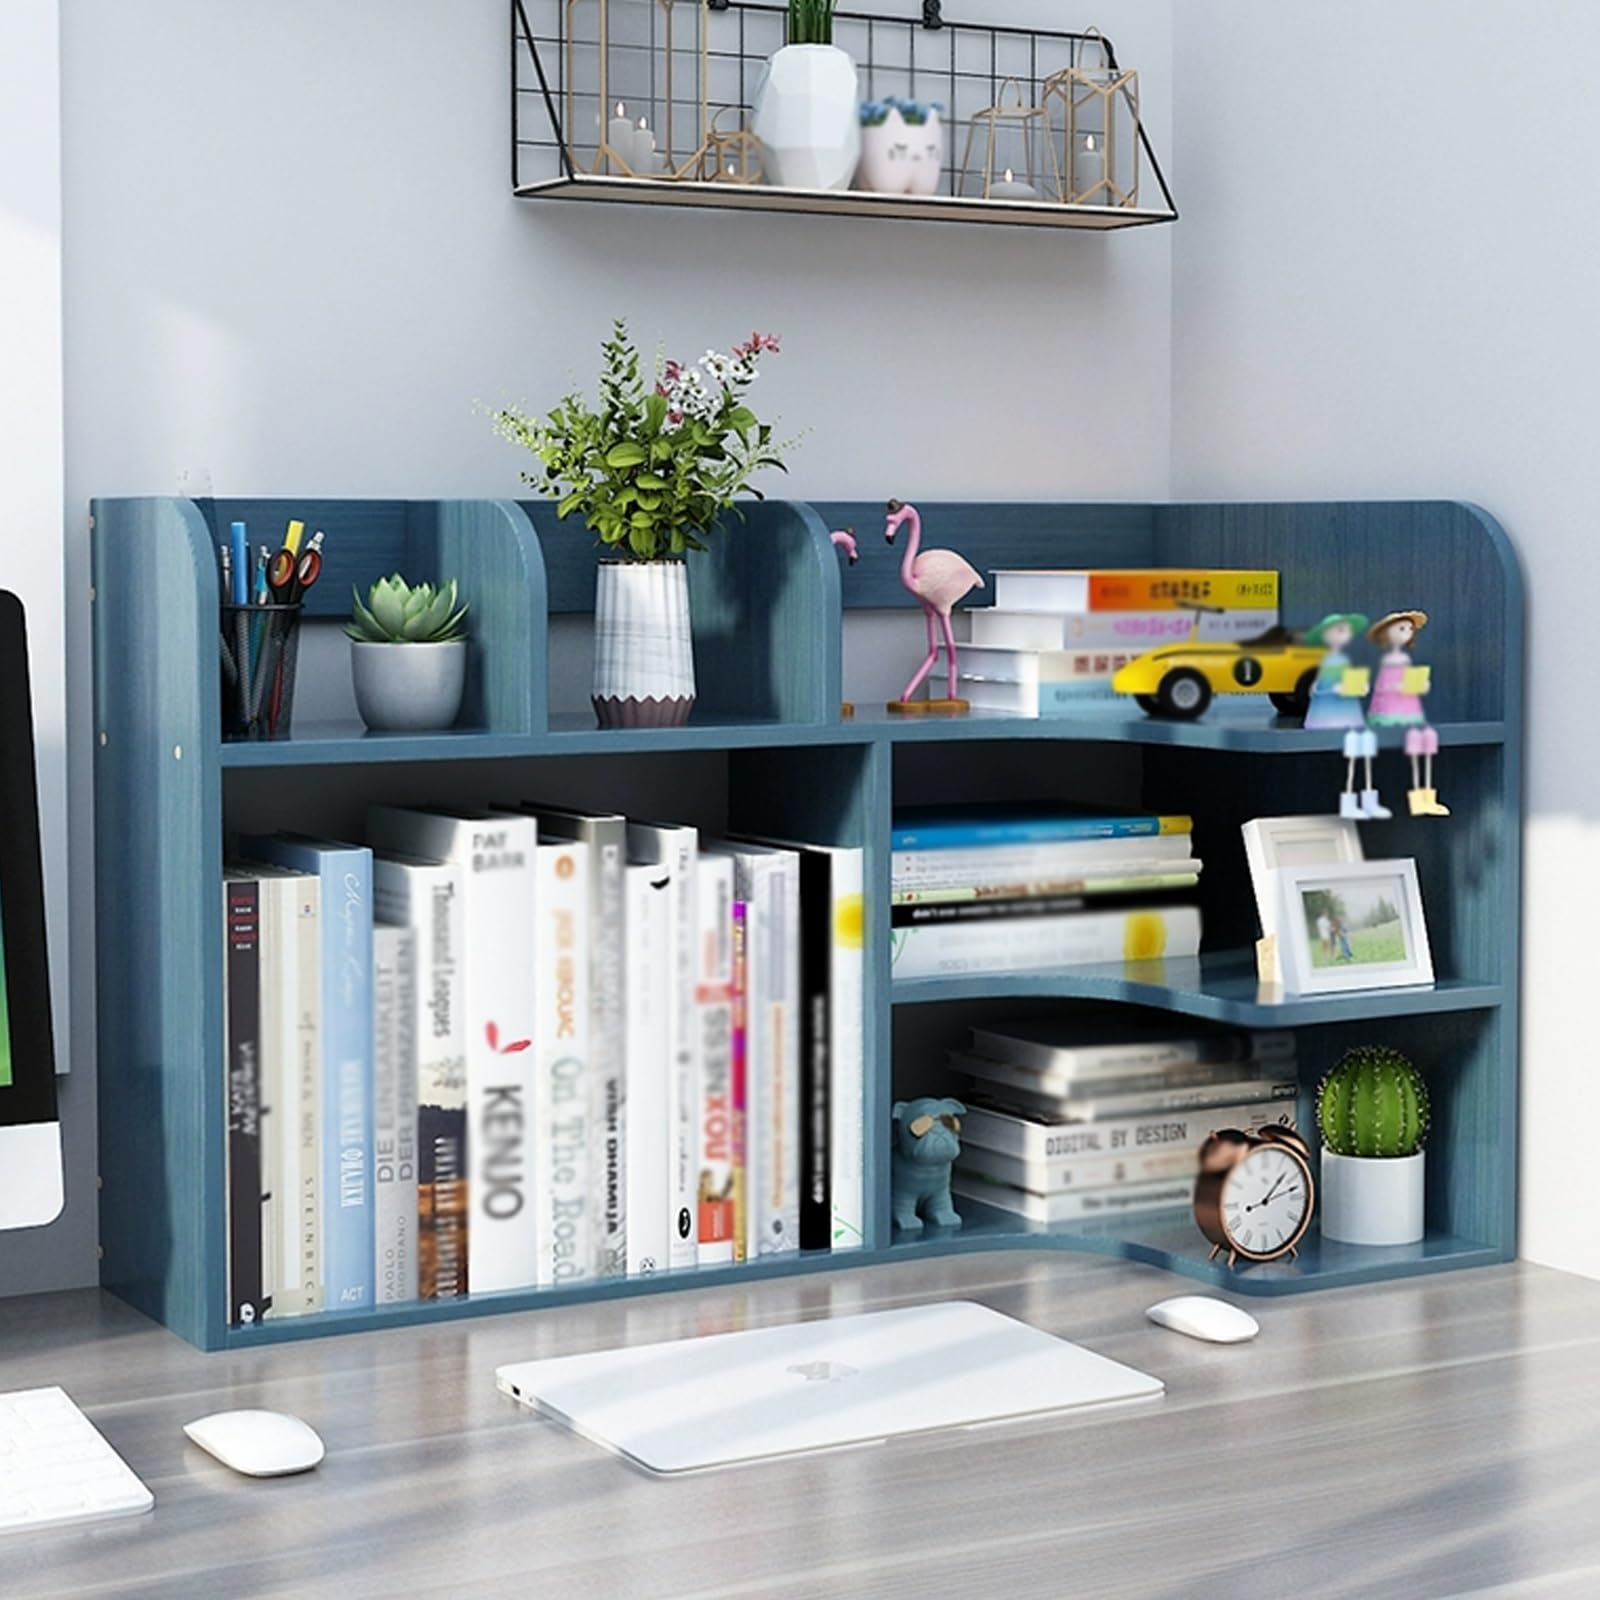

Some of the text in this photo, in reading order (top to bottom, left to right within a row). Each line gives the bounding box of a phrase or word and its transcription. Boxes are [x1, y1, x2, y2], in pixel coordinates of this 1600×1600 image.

[428, 968, 455, 1038] Leagues
[377, 1140, 394, 1184] DIE
[397, 1123, 414, 1182] DER
[482, 1085, 525, 1221] KENJO
[552, 1057, 584, 1284] On The Road
[1046, 1122, 1187, 1156] DIGITAL BY DESIGN
[606, 1138, 619, 1235] DHAMIJA
[304, 1178, 315, 1306] STEINBECK
